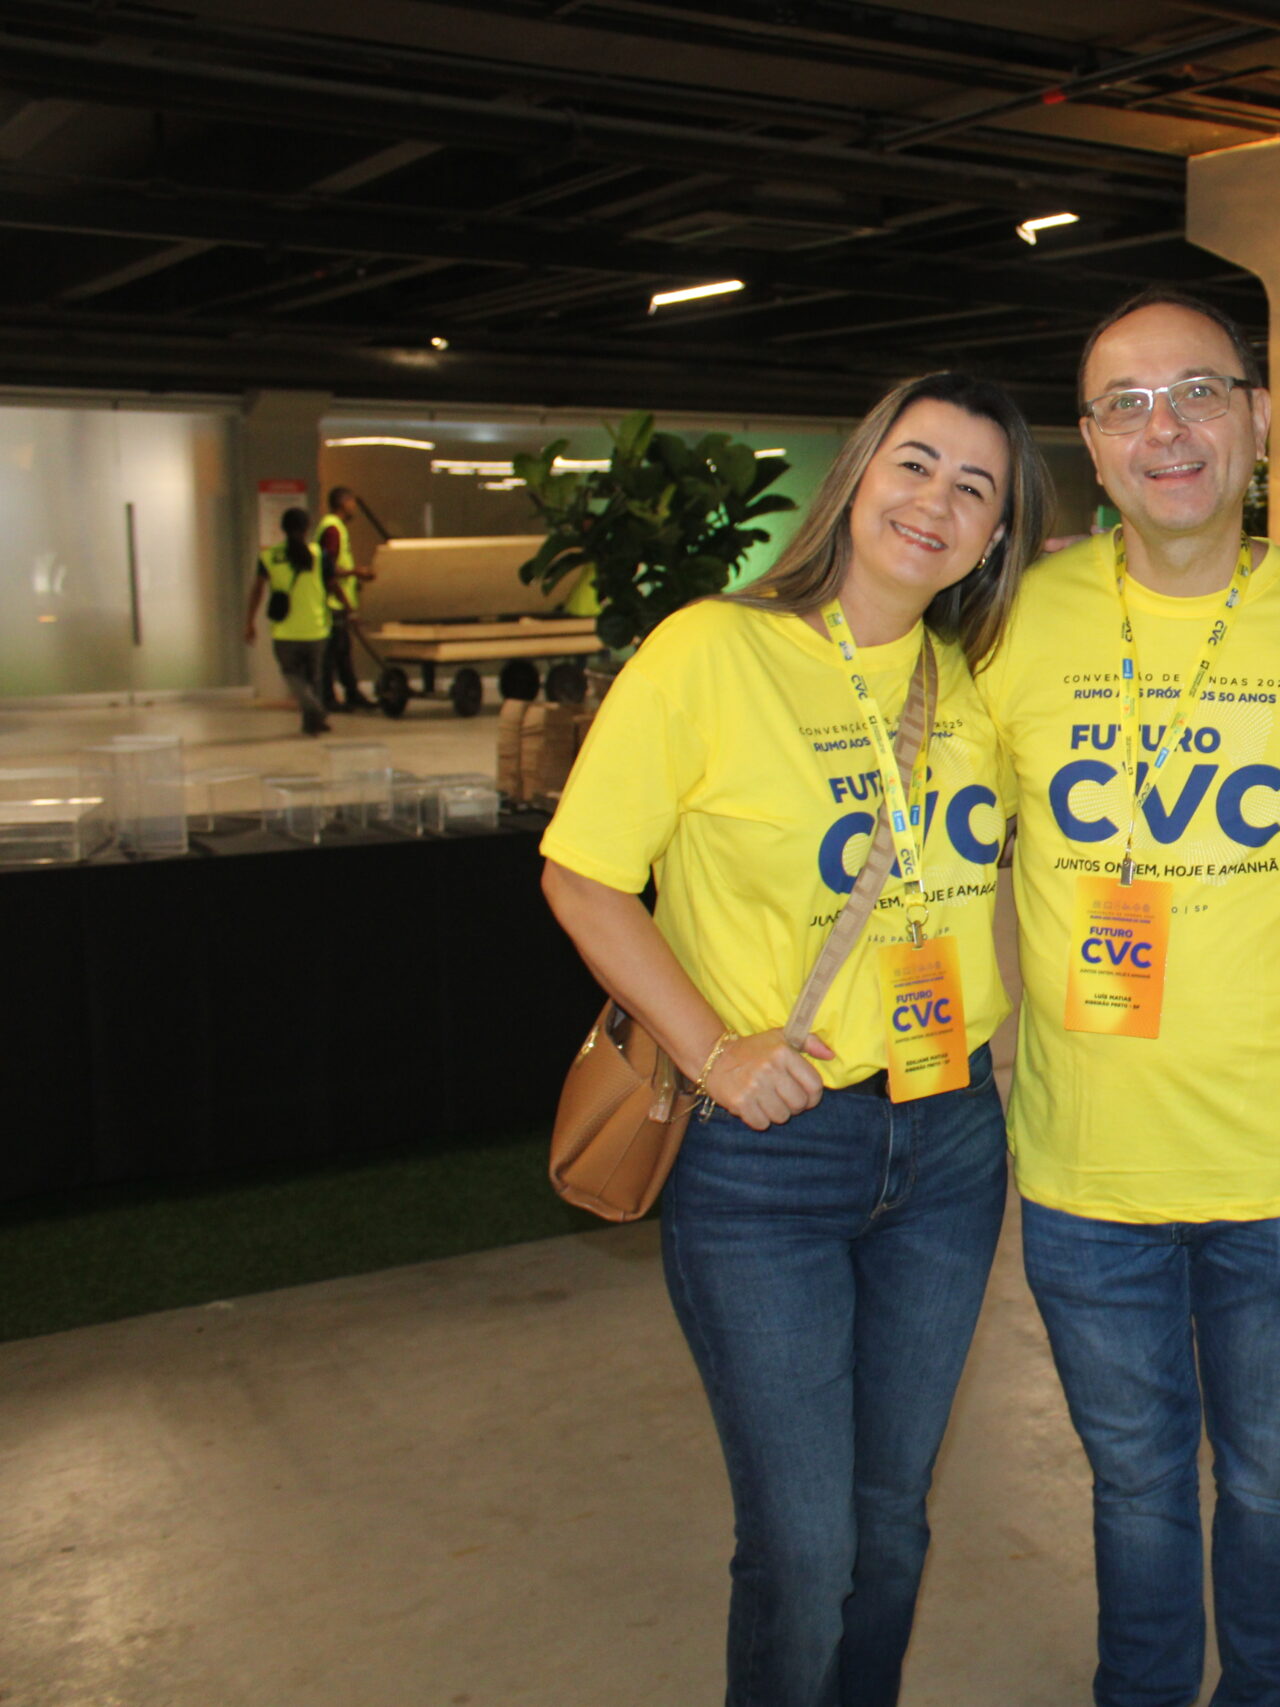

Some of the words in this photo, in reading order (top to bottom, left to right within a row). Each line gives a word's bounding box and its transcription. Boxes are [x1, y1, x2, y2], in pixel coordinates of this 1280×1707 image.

[1207, 620, 1225, 646] CVC
[850, 674, 868, 701] CVC
[1063, 672, 1153, 684] CONVENO
[1162, 672, 1181, 683] DE
[1208, 675, 1249, 687] NDAS
[1074, 688, 1113, 700] RUMO
[1147, 686, 1216, 701] PRÓXOS
[1218, 691, 1236, 703] 50
[1238, 692, 1277, 704] ANOS
[813, 739, 848, 753] RUMO
[850, 736, 872, 749] AOS
[1070, 723, 1222, 755] FUURO
[900, 848, 914, 876] CVC
[1054, 857, 1101, 873] JUNTOS
[1104, 860, 1161, 879] ONEM,
[1163, 863, 1204, 878] HOJE
[1206, 864, 1216, 875] E
[1218, 856, 1280, 876] AMANHÃ
[946, 886, 954, 899] E
[1194, 904, 1209, 912] SP
[890, 932, 928, 944] PAUO
[1089, 926, 1134, 939] FUTURO
[1080, 937, 1153, 969] CVC
[896, 989, 933, 1004] FUTURO
[892, 998, 952, 1032] CVC
